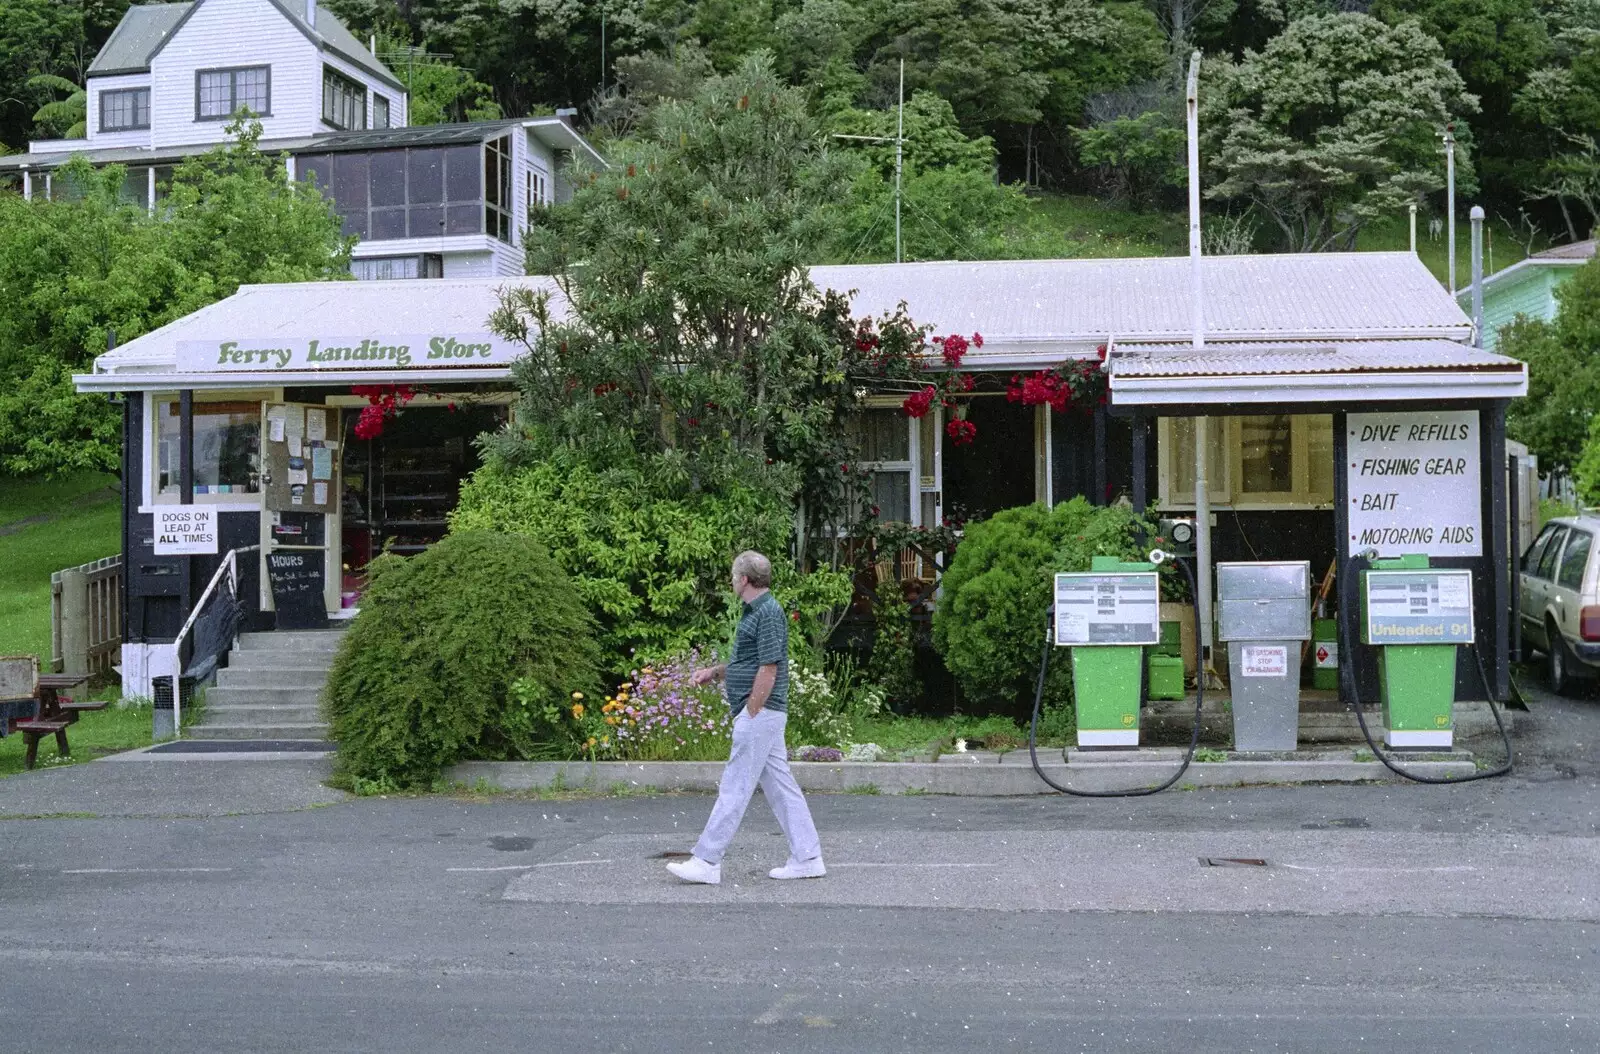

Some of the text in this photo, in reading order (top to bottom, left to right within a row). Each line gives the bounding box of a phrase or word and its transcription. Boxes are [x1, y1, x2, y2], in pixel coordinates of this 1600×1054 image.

[217, 336, 492, 368] Ferry Landing Store
[1360, 424, 1469, 442] DIVE REFILLS
[1361, 458, 1466, 476] FISHING GEAR
[1361, 493, 1399, 511] BAIT
[162, 512, 209, 522] DOGS ON
[165, 523, 206, 533] LEAD AT
[1360, 526, 1474, 545] MOTORING AIDS
[159, 535, 179, 544] ALL
[183, 533, 213, 543] TIMES
[271, 555, 304, 567] HOURS
[1372, 623, 1468, 636] Unleaded 91
